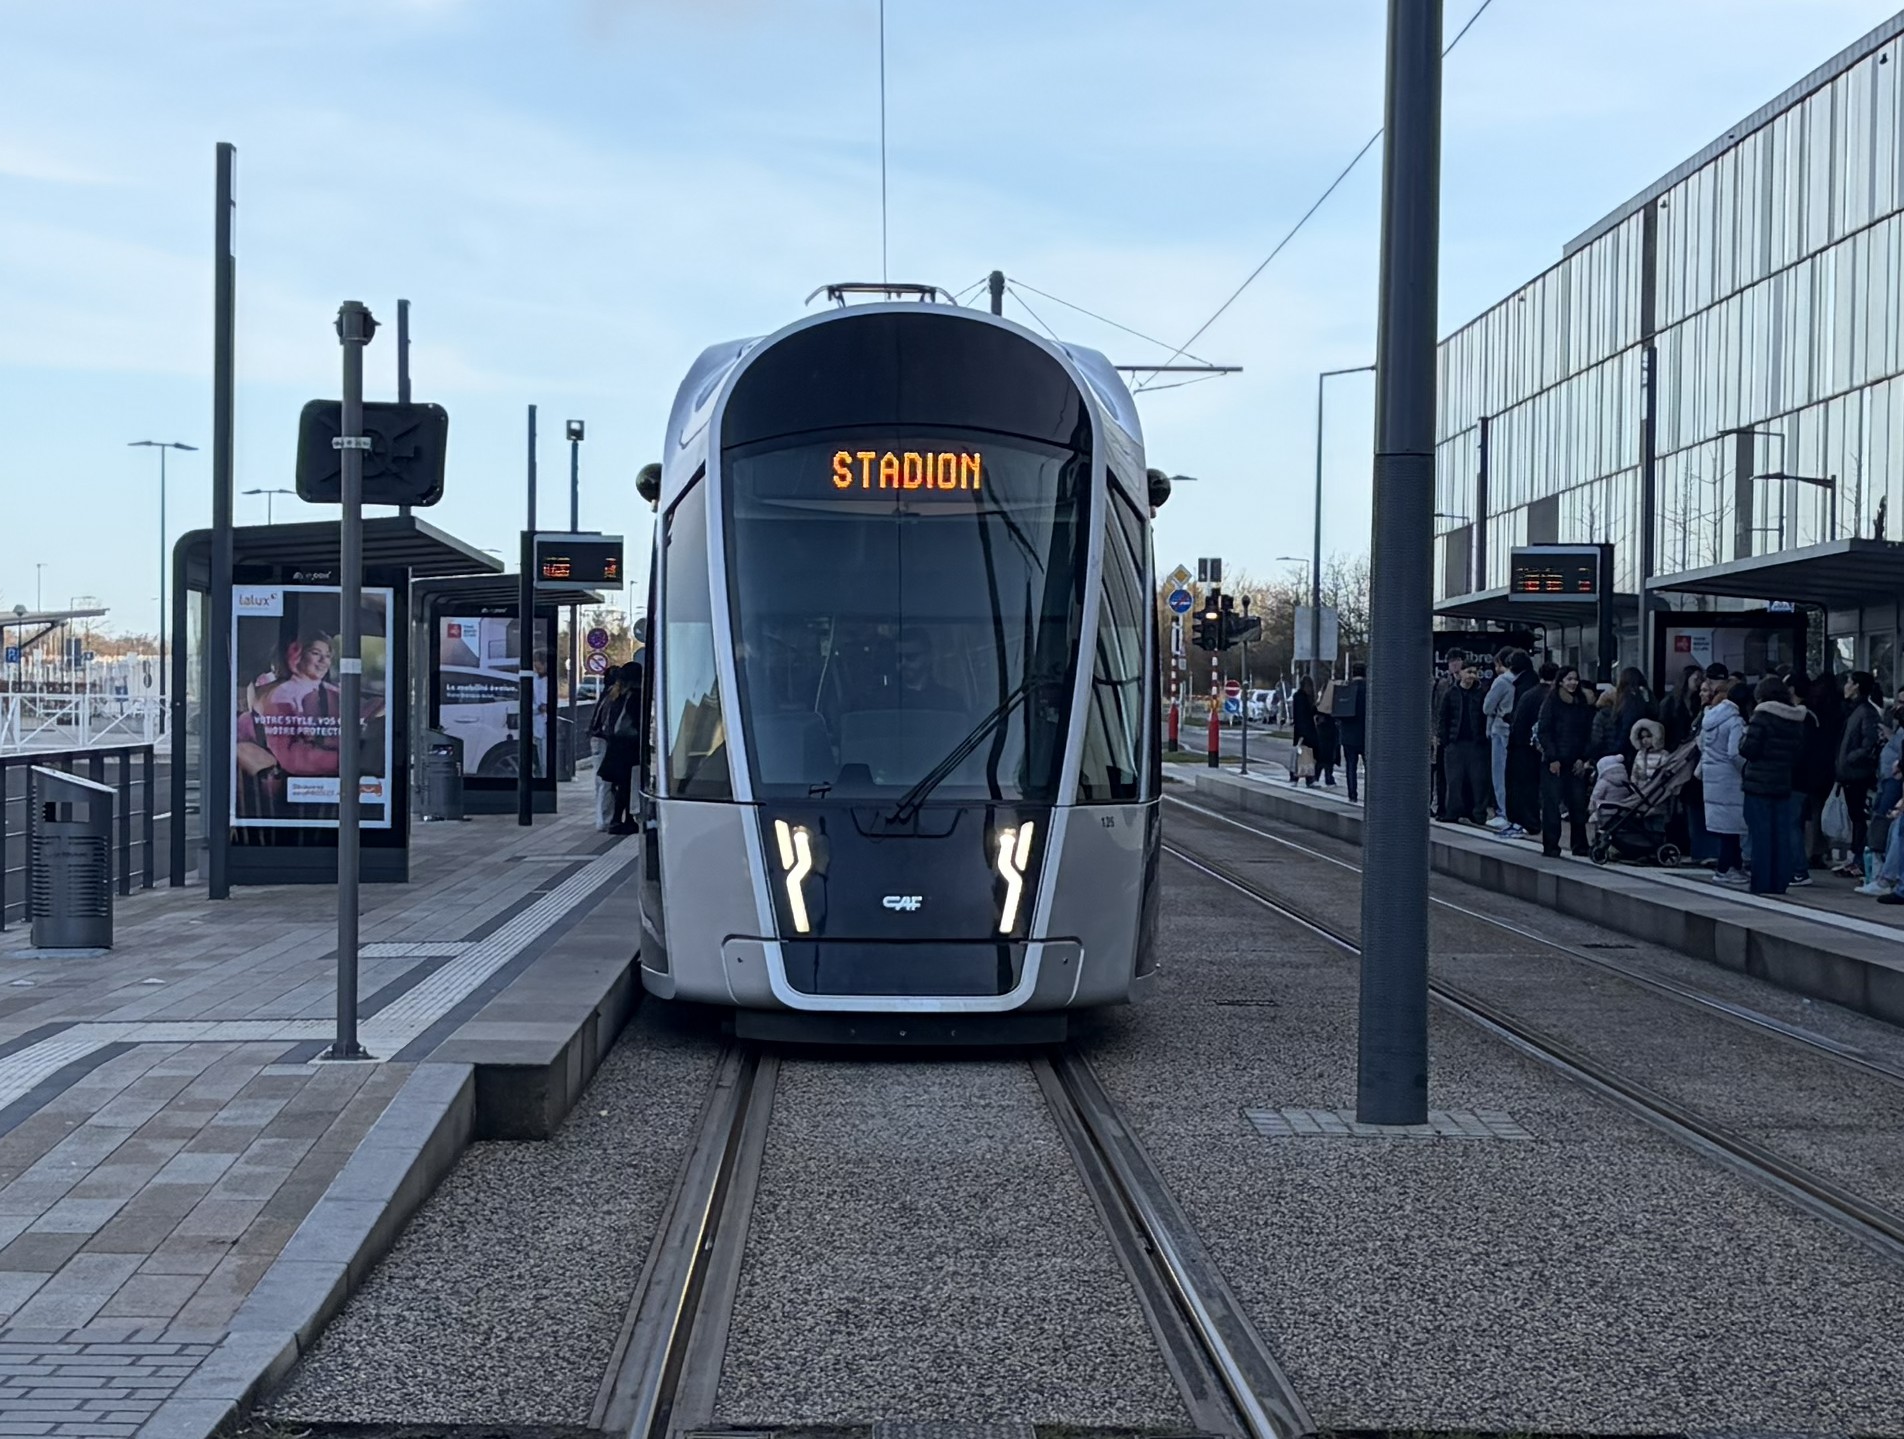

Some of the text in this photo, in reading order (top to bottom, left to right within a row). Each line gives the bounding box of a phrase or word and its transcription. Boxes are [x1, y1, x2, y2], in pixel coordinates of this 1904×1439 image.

[833, 451, 982, 490] STADION
[239, 594, 270, 606] lalux
[1465, 651, 1494, 664] ibre
[254, 715, 283, 725] VOTRE
[318, 716, 335, 726] VOS
[264, 727, 341, 737] NOTRE PROTECT
[882, 895, 923, 911] CAF
